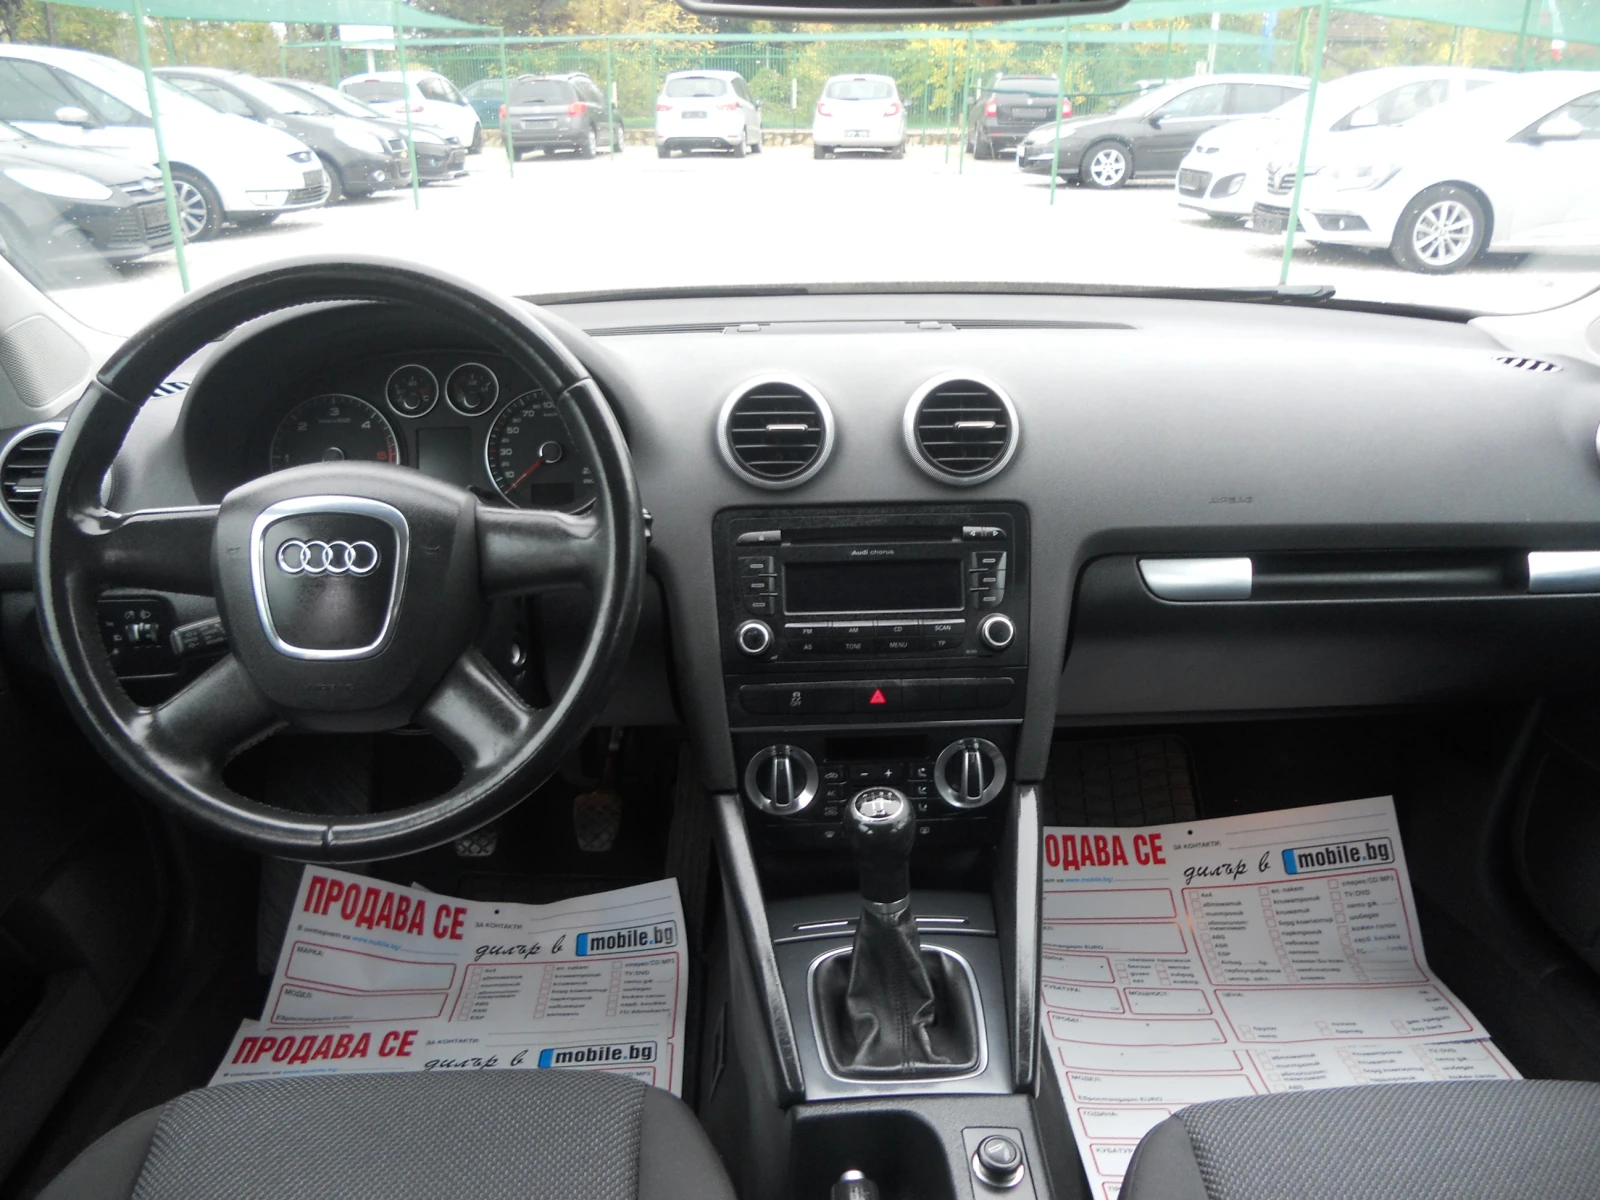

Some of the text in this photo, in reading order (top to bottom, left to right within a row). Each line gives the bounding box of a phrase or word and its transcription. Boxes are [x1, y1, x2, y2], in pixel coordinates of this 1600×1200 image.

[298, 422, 308, 430] 2
[329, 407, 340, 416] 3
[1044, 832, 1167, 871] ОДАВА СЕ
[1183, 840, 1222, 849] КОНТАКТИ:
[1183, 859, 1248, 885] дилър
[1298, 841, 1390, 869] mobile.bg
[303, 875, 467, 940] ПРОДАВА СЕ
[474, 942, 541, 962] дилър
[590, 926, 674, 951] mobile.bg
[232, 1030, 418, 1065] ПРОДАВА СЕ
[555, 1044, 652, 1066] mobile.bg
